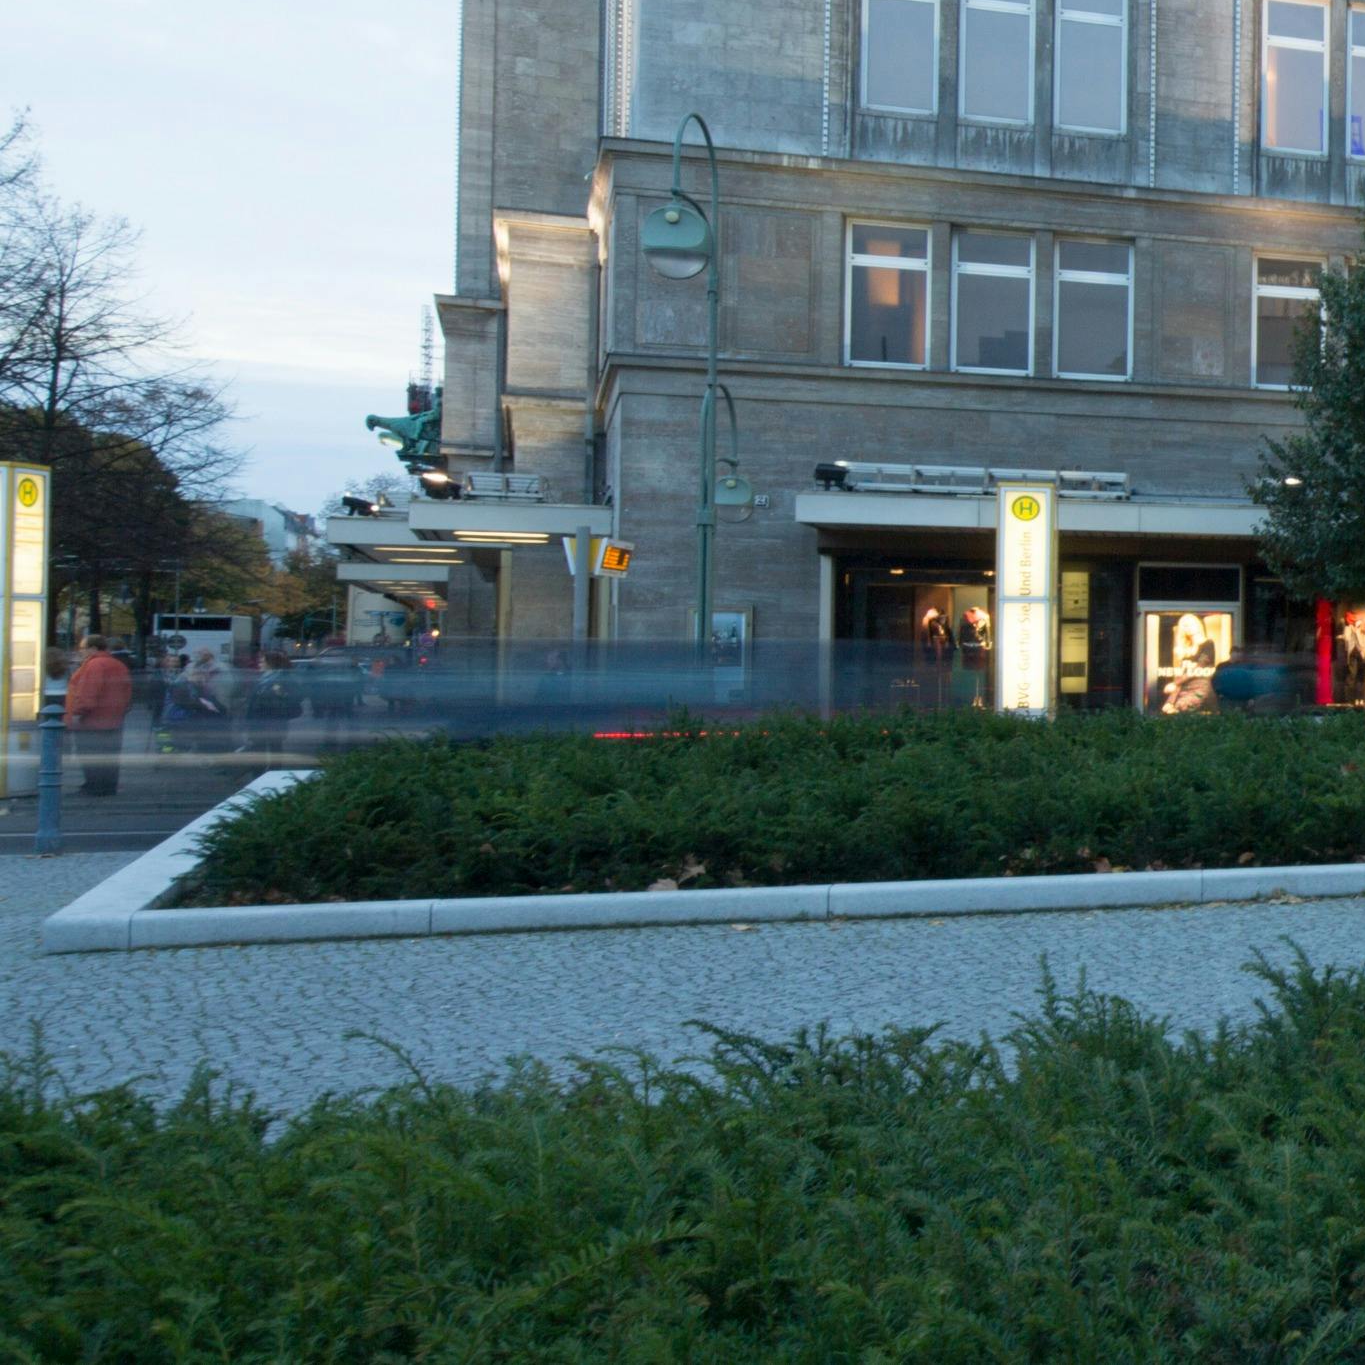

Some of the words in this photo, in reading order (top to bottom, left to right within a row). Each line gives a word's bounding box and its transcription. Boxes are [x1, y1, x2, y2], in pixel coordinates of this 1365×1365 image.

[1019, 531, 1031, 567] Berlin
[1019, 573, 1031, 596] Und
[1017, 681, 1031, 709] BVG
